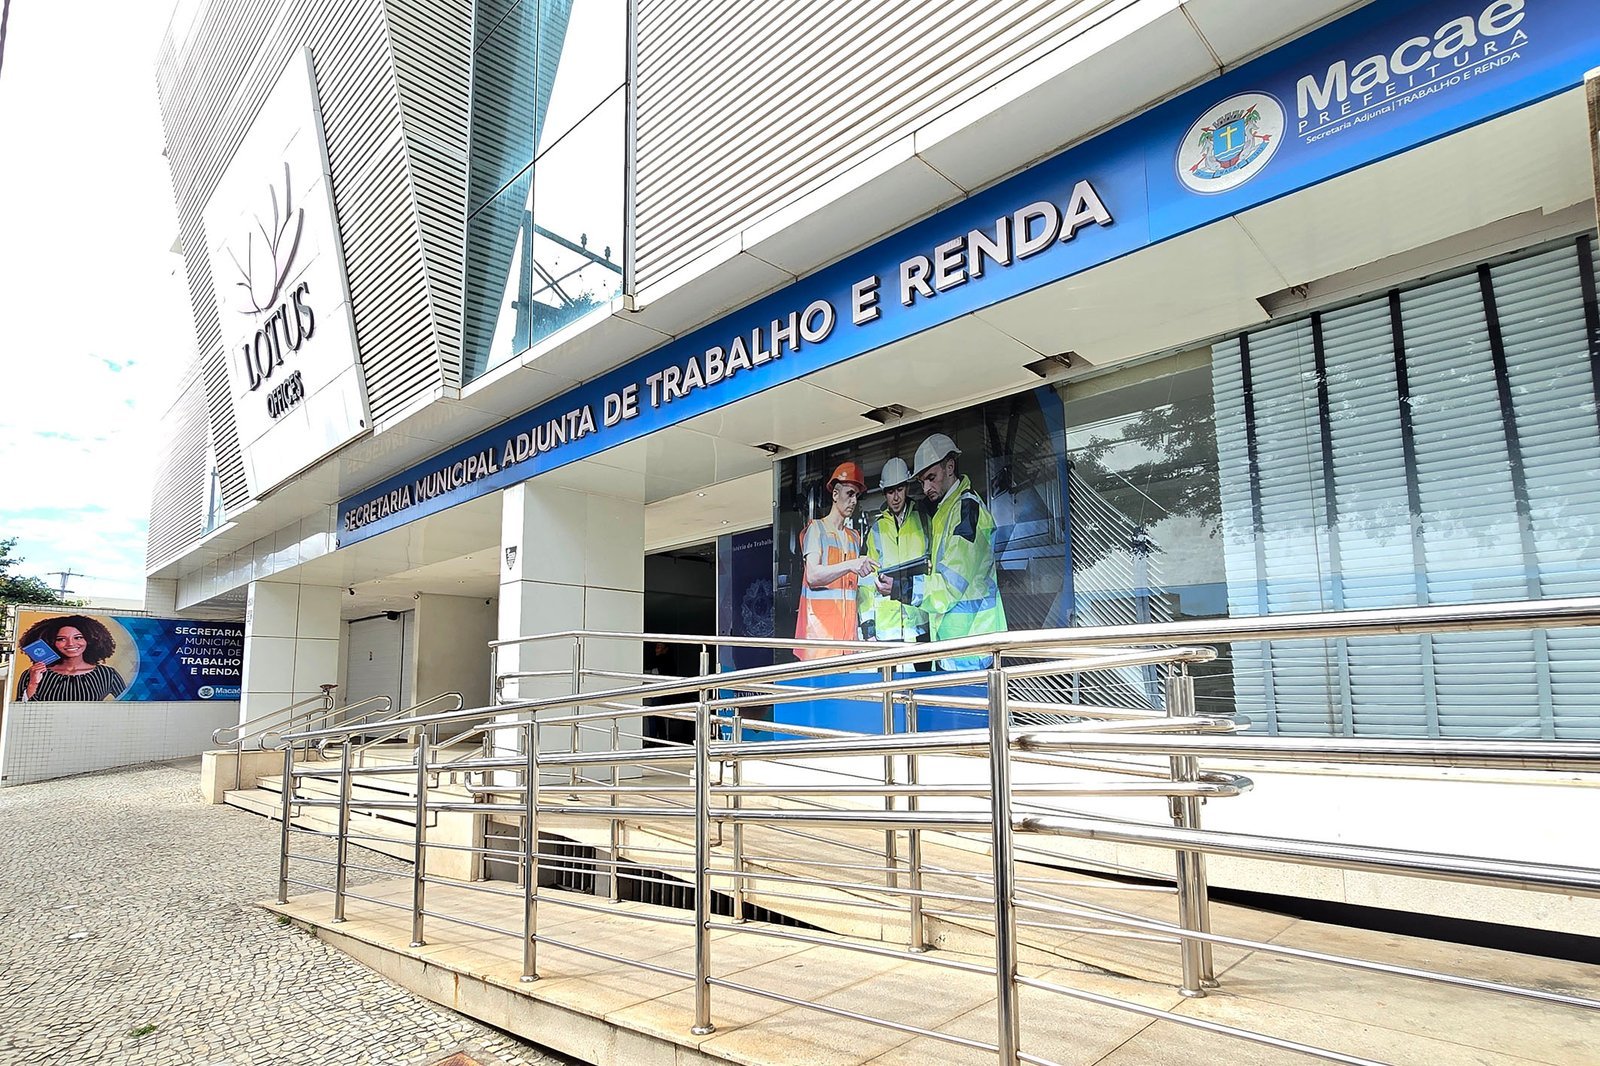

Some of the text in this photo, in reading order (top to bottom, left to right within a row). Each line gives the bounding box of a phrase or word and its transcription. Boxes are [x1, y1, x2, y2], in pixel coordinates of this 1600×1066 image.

[1298, 29, 1528, 133] PREFEITURA
[1306, 121, 1351, 145] Secretaria
[1353, 105, 1391, 126] Adjunta
[1396, 76, 1460, 107] TRABALHO
[1463, 70, 1472, 81] E
[1474, 51, 1521, 76] RENDA
[242, 281, 316, 392] LOTUS
[343, 485, 412, 532] SECRETARIA
[415, 447, 501, 506] MUNICIPAL
[502, 404, 598, 469] ADJUNTA
[603, 383, 640, 428] DE
[646, 300, 836, 408] TRABALHO
[851, 275, 880, 325] E
[900, 179, 1114, 306] RENDA
[266, 369, 306, 419] OFFICES
[175, 626, 243, 637] SECRETARIA
[185, 637, 242, 647] MUNICIPAL
[175, 647, 241, 656] ADJUNTA DE
[180, 656, 241, 666] TRABALHO
[190, 667, 240, 676] E RENDA
